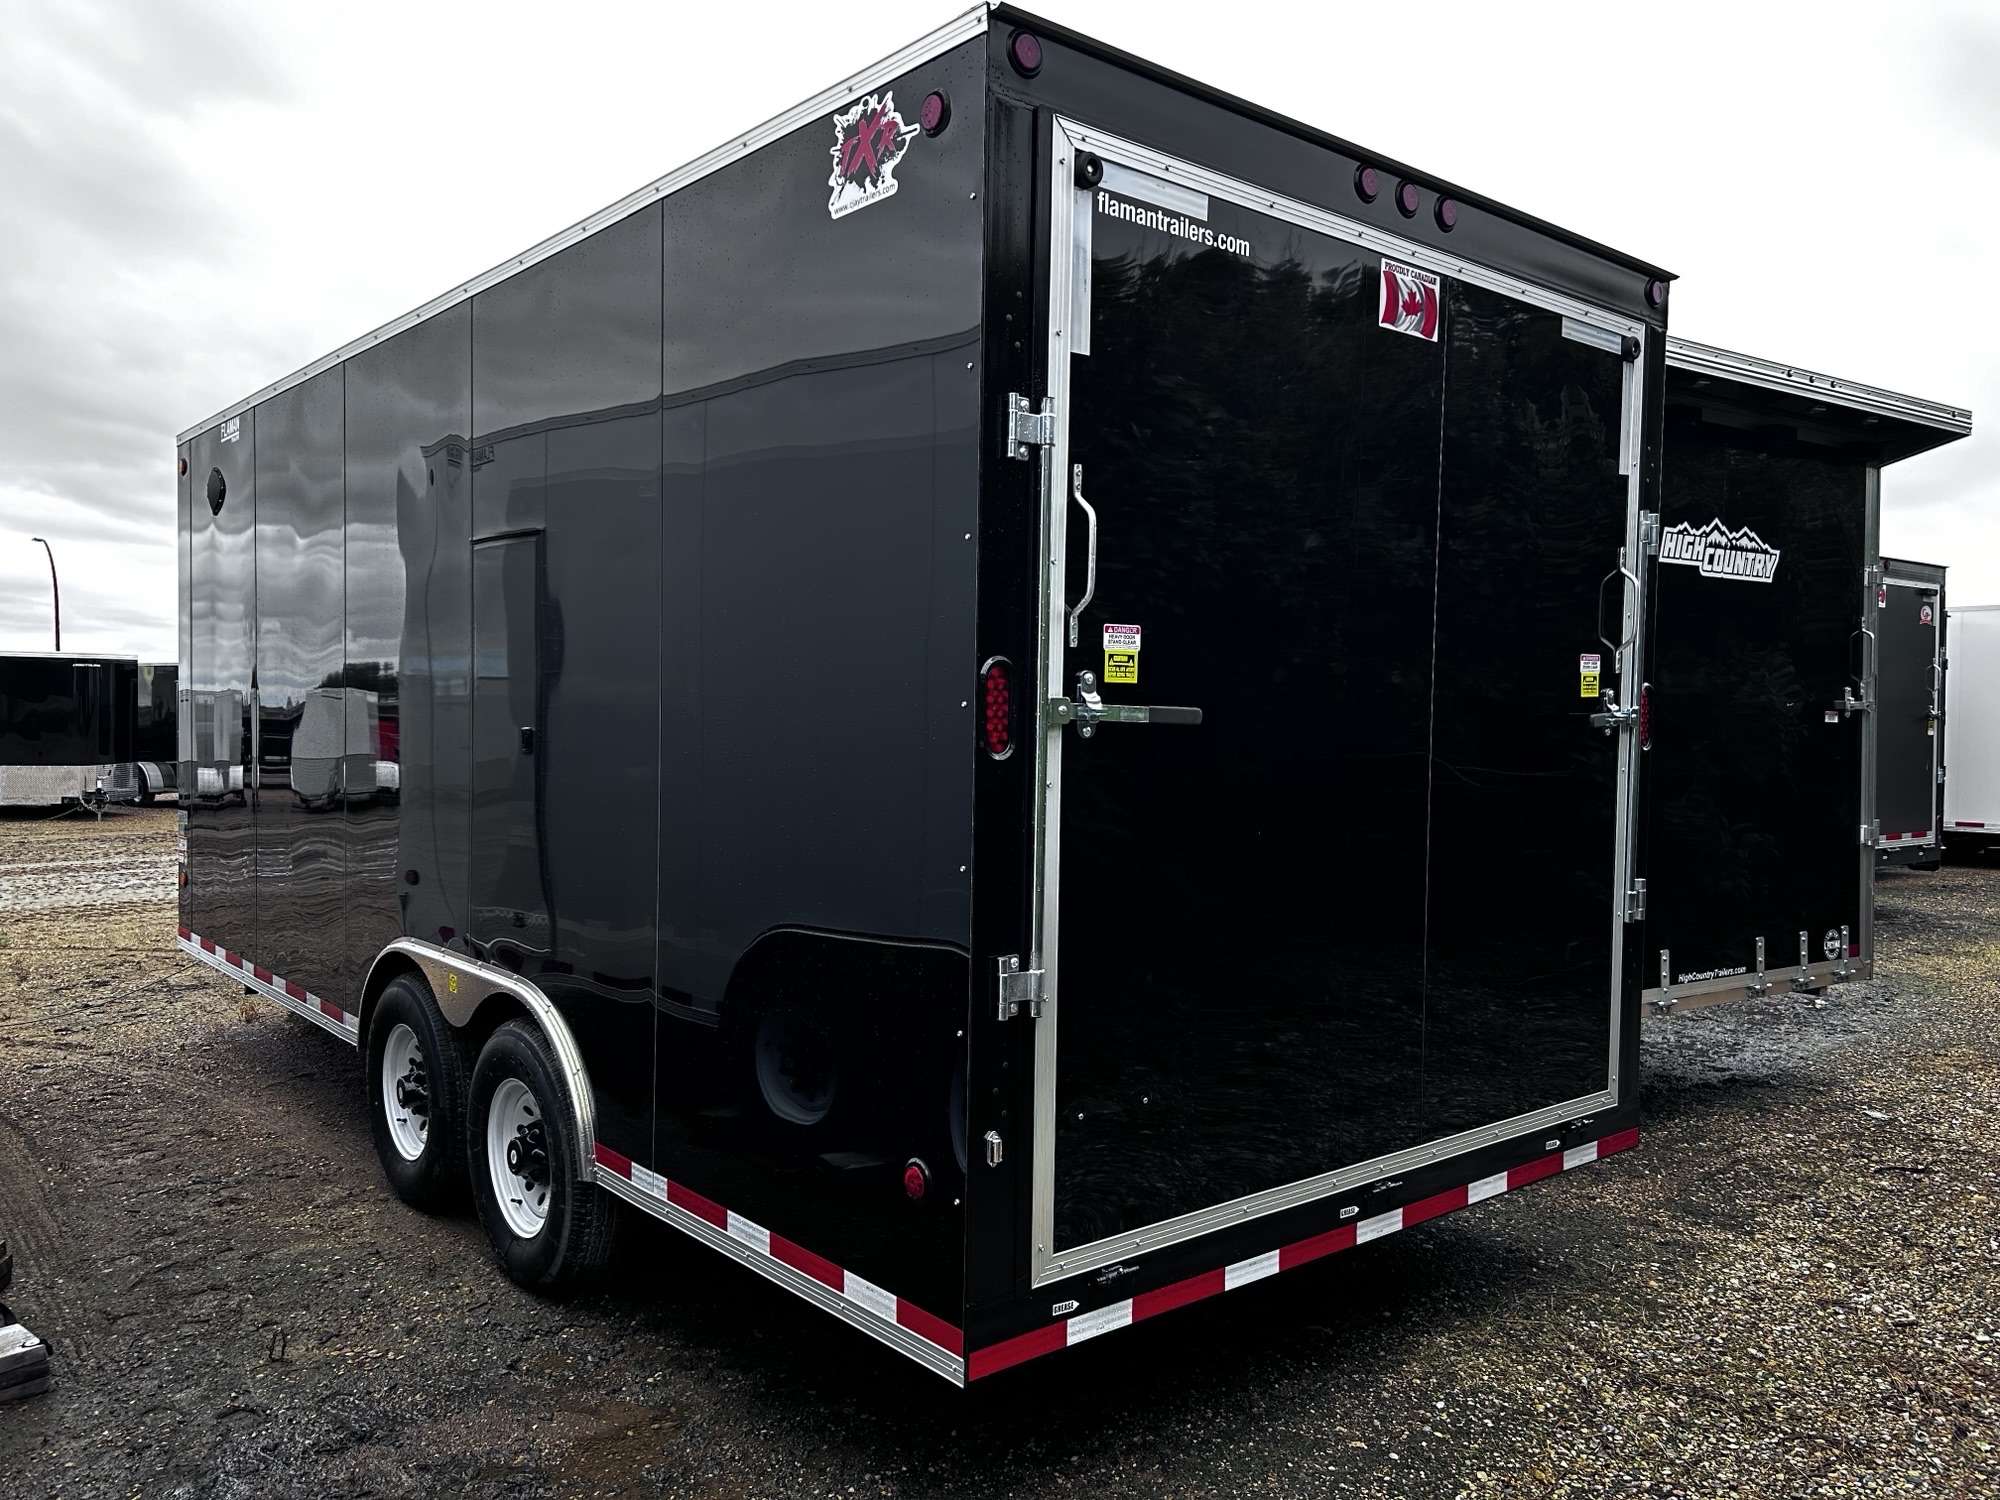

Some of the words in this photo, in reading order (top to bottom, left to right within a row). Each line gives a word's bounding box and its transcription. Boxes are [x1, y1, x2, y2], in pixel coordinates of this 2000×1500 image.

[1097, 192, 1250, 257] flamantrailers.com
[1384, 261, 1410, 278] PROUDLY
[1410, 270, 1437, 286] CANADIAN
[1663, 532, 1706, 561] HIGH
[1702, 546, 1777, 578] COUNTRY
[1113, 626, 1138, 634] DANGER
[1054, 1301, 1074, 1314] GREASE
